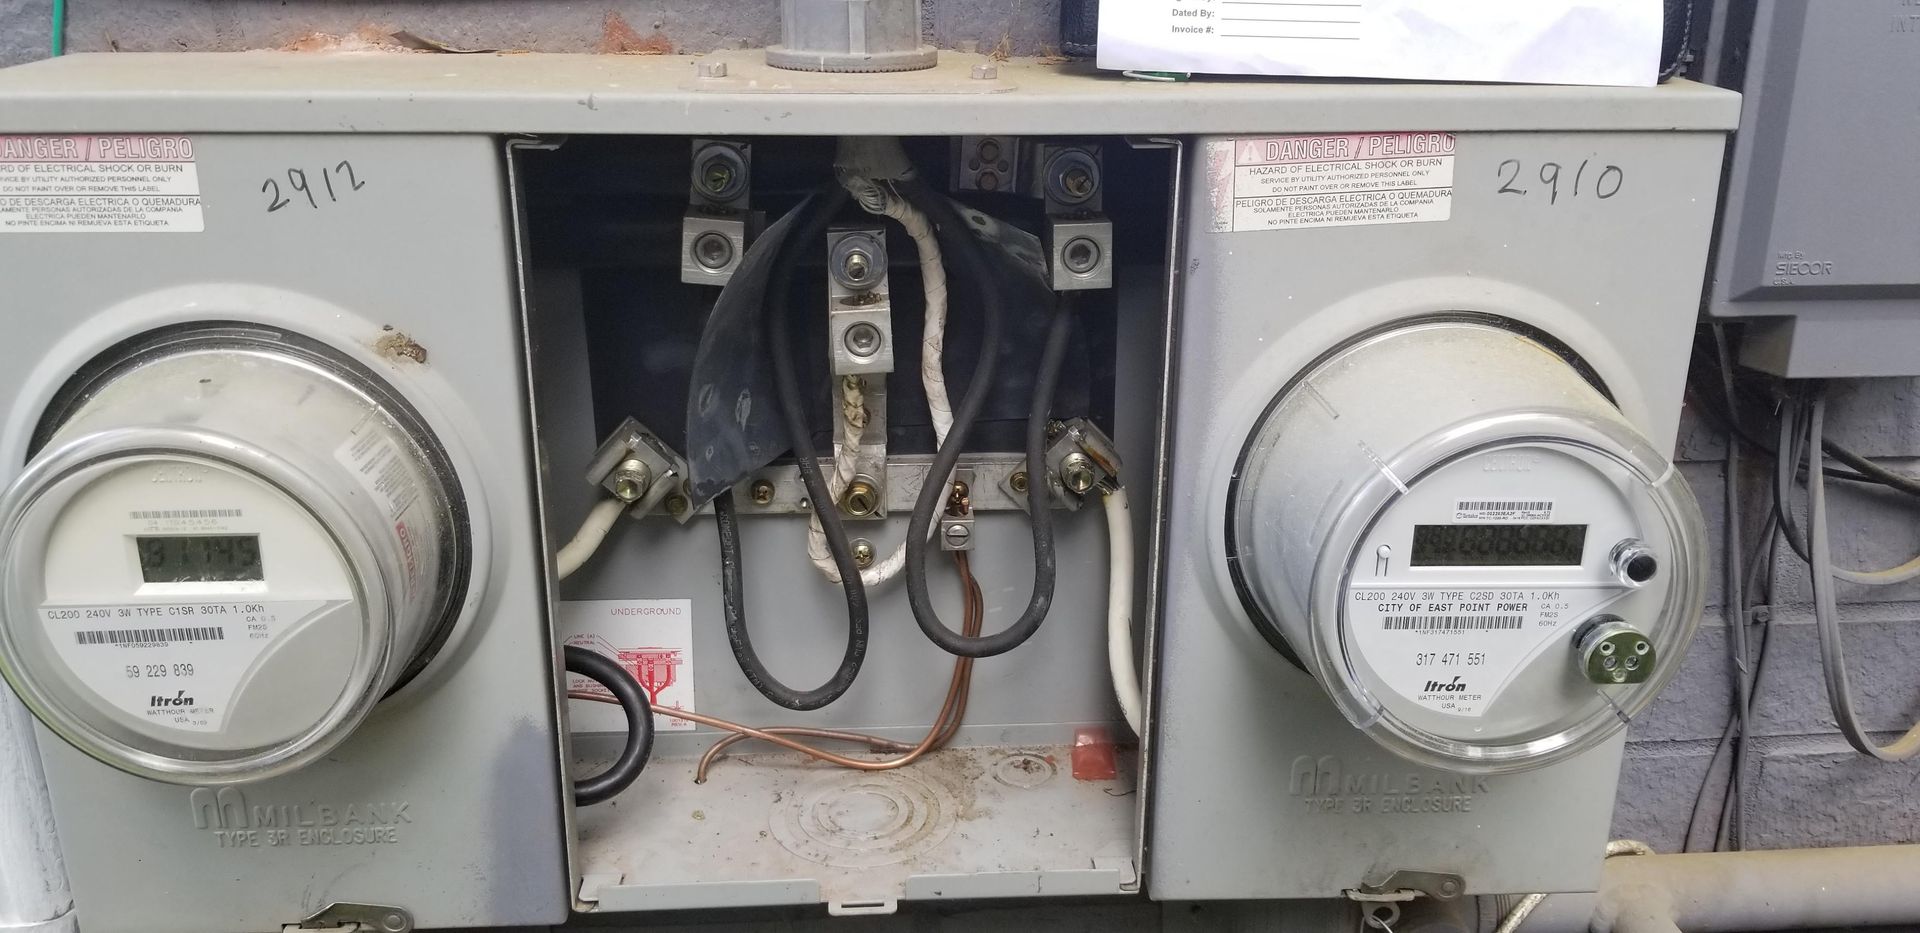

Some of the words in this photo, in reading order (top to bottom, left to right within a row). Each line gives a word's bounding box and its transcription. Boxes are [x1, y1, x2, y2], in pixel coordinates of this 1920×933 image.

[1172, 8, 1198, 17] Dated
[1200, 9, 1215, 19] By:
[1172, 25, 1204, 33] Invoice
[1205, 26, 1214, 34] #:
[0, 136, 78, 158] ANGER
[98, 136, 193, 158] PELIGRO
[1266, 138, 1349, 161] DANGER
[1368, 133, 1456, 156] PELIGRO
[17, 164, 31, 173] OF
[34, 164, 96, 173] ELECTRICAL
[98, 164, 135, 173] SHOCK
[136, 164, 152, 173] OR
[154, 164, 183, 173] BURN
[1249, 165, 1288, 175] HAZARD
[1290, 165, 1303, 174] OF
[1305, 161, 1362, 173] ELECTRICAL
[1364, 159, 1398, 170] SHOCK
[1399, 159, 1414, 168] OR
[1416, 158, 1443, 167] BURN
[1327, 173, 1369, 181] AUTHORIZED
[1370, 171, 1410, 179] PERSONNEL
[1498, 157, 1623, 206] 2910
[262, 160, 365, 213] 2912
[1299, 184, 1318, 192] PAINT
[9, 198, 22, 206] DE
[24, 198, 77, 206] DESCARGA
[78, 198, 129, 206] ELECTRICA
[131, 198, 140, 206] O
[141, 198, 200, 206] QUEMADURA
[1236, 198, 1274, 208] PELIGRO
[1275, 198, 1287, 206] DE
[1289, 196, 1338, 206] DESCARGA
[1339, 192, 1387, 203] ELECTRICA
[1388, 192, 1396, 200] O
[1397, 189, 1453, 200] QUEMADURA
[1253, 206, 1293, 214] SOLAMENTE
[1294, 204, 1331, 212] PERSONAS
[1332, 202, 1378, 210] AUTORIZADAS
[1287, 210, 1324, 218] ELECTRICA
[1353, 207, 1399, 215] MANTENARLO
[1300, 217, 1326, 225] ENCIMA
[1775, 261, 1832, 275] SIECOR
[1355, 591, 1386, 601] CL200
[1391, 591, 1416, 601] 240V
[1422, 591, 1435, 601] 3W
[1440, 591, 1464, 601] TYPE
[1470, 591, 1495, 601] C2SD
[1500, 591, 1524, 601] 30TA
[1530, 591, 1560, 601] 1.0Kh
[48, 610, 80, 619] CL200
[86, 609, 111, 619] 240V
[118, 608, 131, 617] 3W
[137, 607, 163, 617] TYPE
[168, 606, 195, 616] C1SR
[201, 605, 227, 615] 30TA
[232, 603, 264, 614] 1.0Kh
[610, 607, 682, 616] UNDERGROUND
[1378, 603, 1403, 612] CITY
[1409, 603, 1422, 612] OF
[1428, 603, 1453, 612] EAST
[1460, 603, 1490, 612] POINT
[1496, 603, 1528, 612] POWER
[1416, 652, 1436, 666] 317
[1441, 652, 1460, 666] 471
[1467, 652, 1486, 666] 551
[126, 665, 140, 678] 59
[146, 664, 167, 678] 229
[173, 663, 194, 677] 839
[1345, 773, 1490, 796] MILBANK
[1305, 797, 1345, 815] TYPE
[1380, 795, 1473, 814] ENCLOSURE
[253, 800, 412, 828] MILBANK
[214, 830, 260, 848] TYPE
[266, 829, 290, 847] 3R
[299, 826, 399, 846] ENCLOSURE
